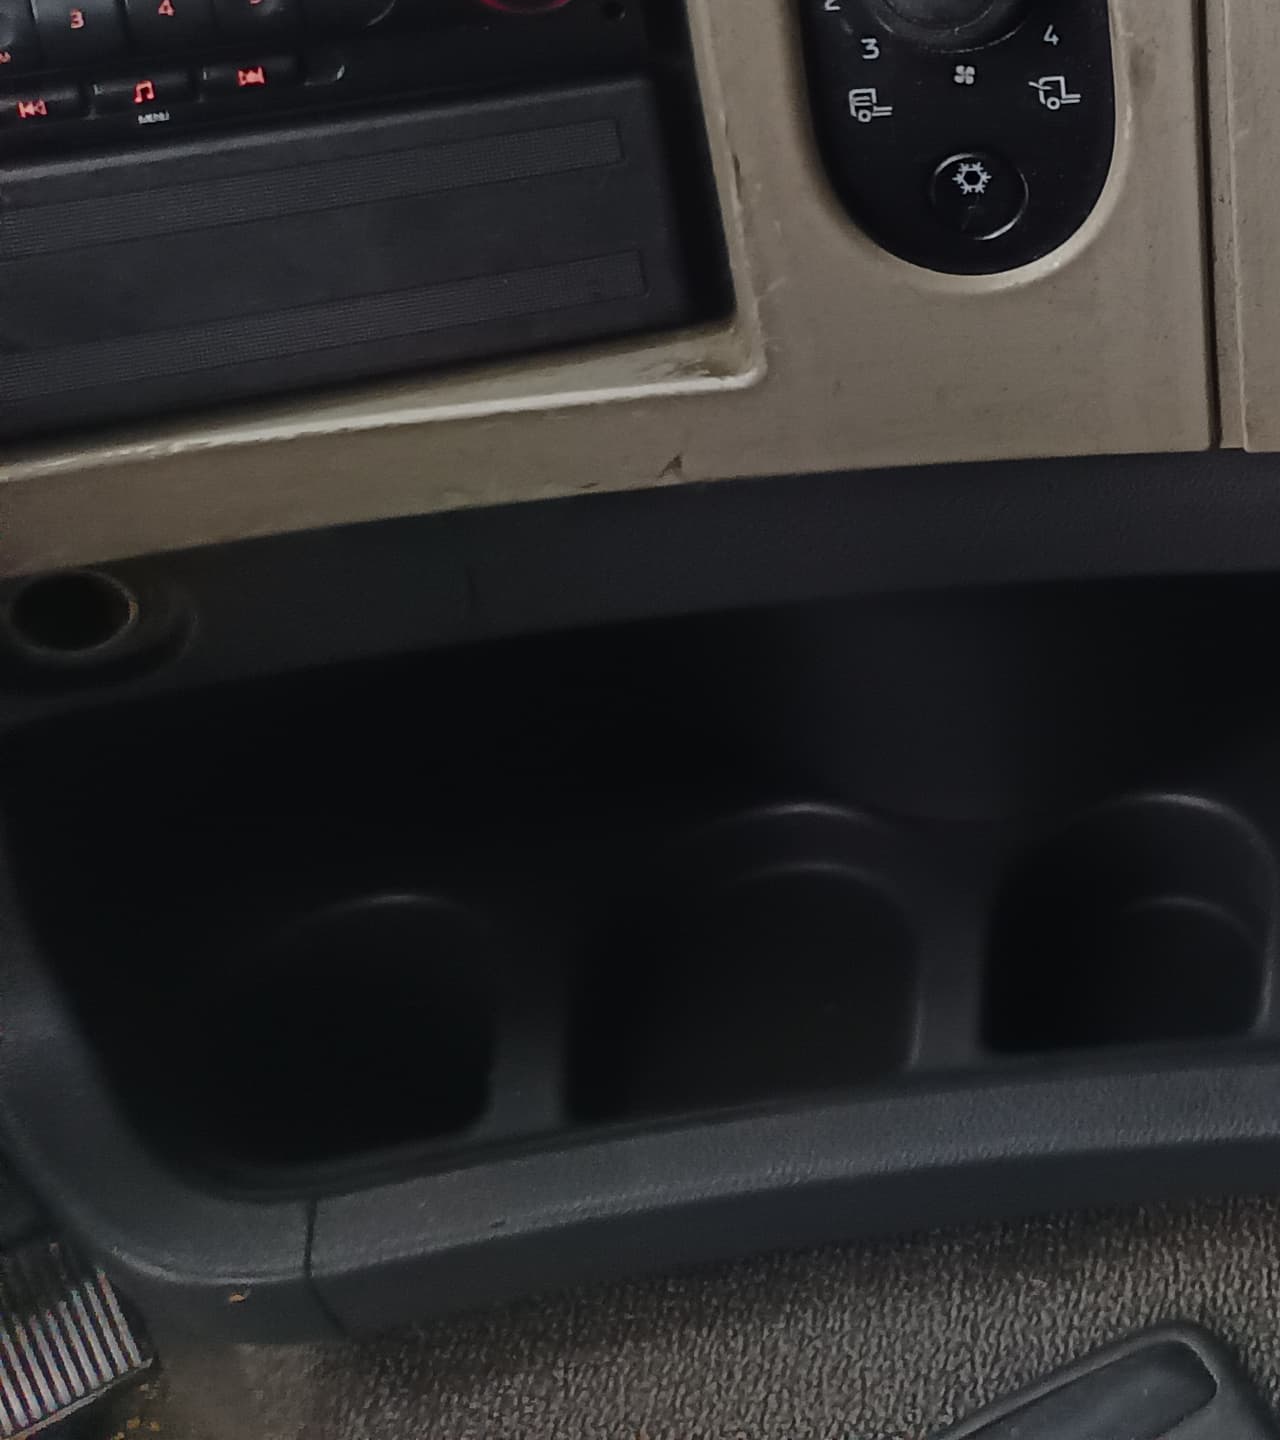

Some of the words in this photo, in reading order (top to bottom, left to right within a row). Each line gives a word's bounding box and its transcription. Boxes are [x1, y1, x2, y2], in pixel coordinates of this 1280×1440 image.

[158, 0, 175, 16] 4
[70, 9, 84, 29] 3
[1044, 25, 1060, 46] 4
[862, 38, 880, 60] 3
